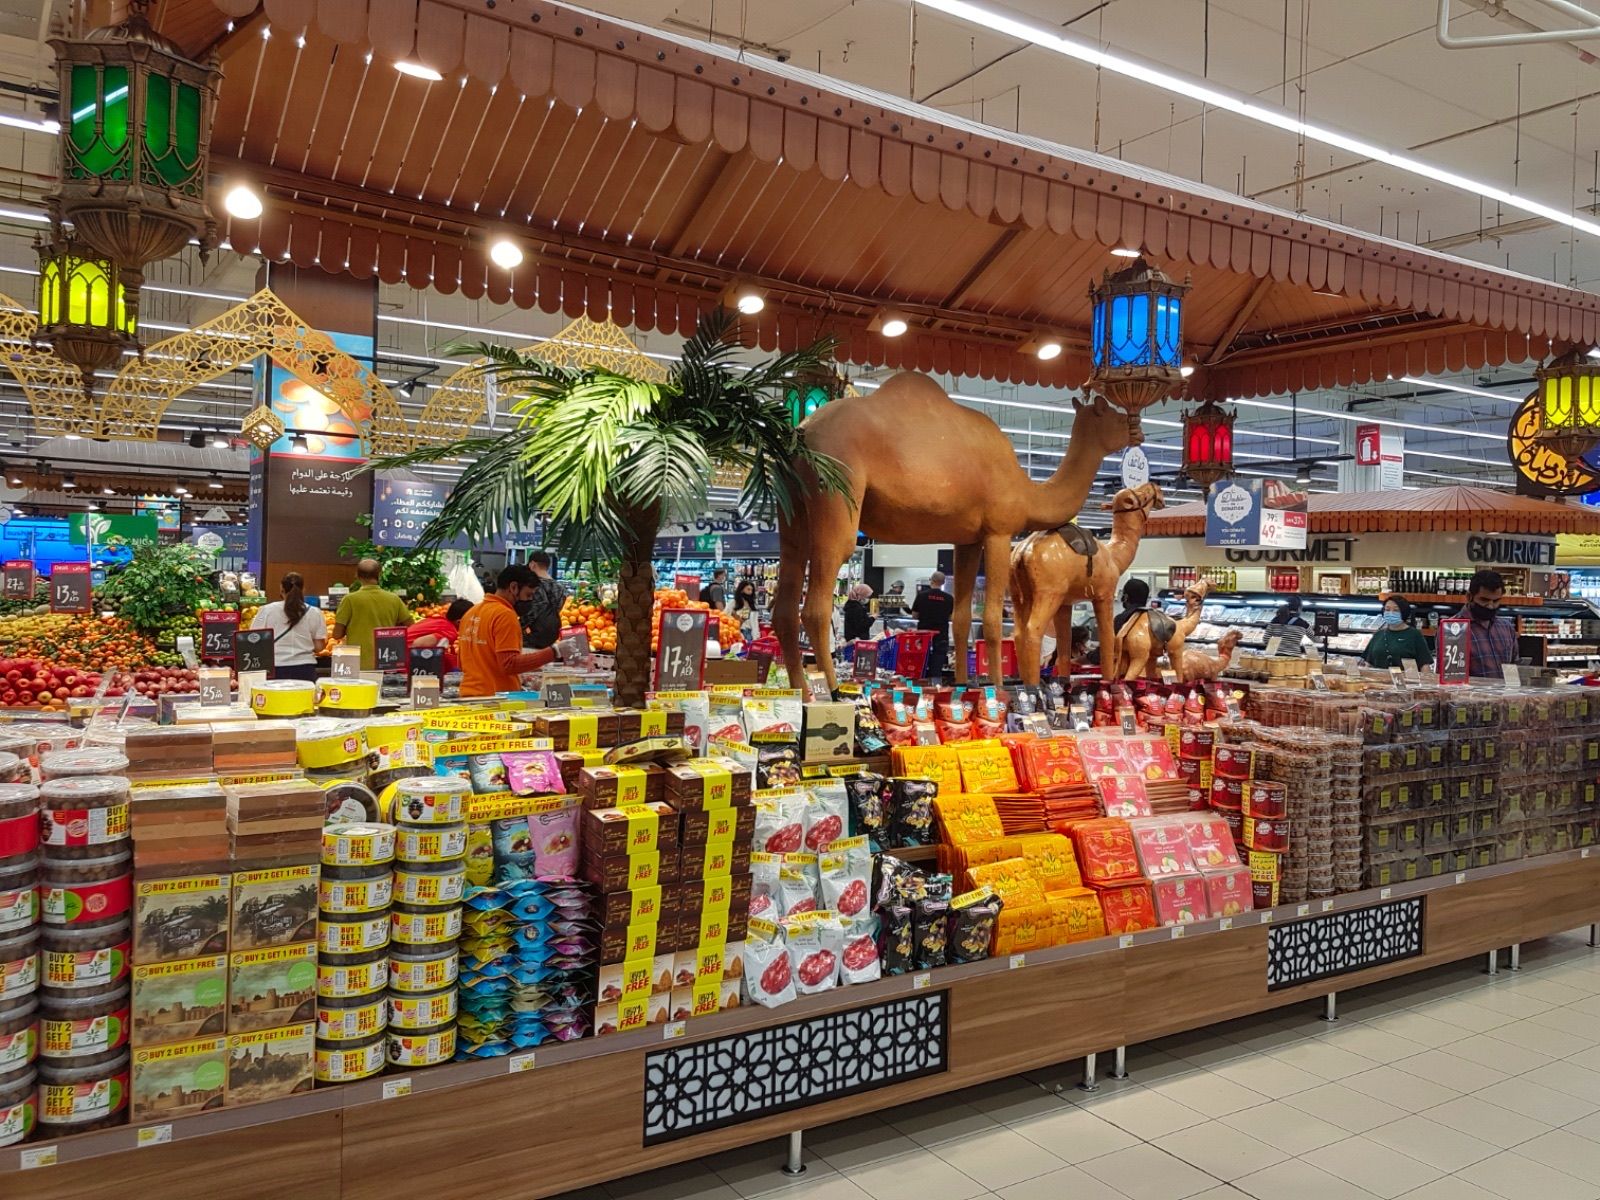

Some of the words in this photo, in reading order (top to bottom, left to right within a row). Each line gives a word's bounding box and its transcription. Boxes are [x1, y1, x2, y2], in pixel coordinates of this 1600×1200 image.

[292, 469, 313, 478] الدوام
[316, 470, 328, 480] على
[289, 484, 308, 495] عليها
[309, 486, 331, 494] تعتمد
[332, 488, 353, 498] وقيمة
[1226, 538, 1354, 562] GOURMET
[1467, 536, 1557, 565] GOURMET
[680, 666, 692, 675] AED
[490, 723, 512, 731] FREE
[450, 745, 469, 753] BUY
[480, 743, 496, 751] GET
[509, 740, 533, 748] FREE
[107, 806, 121, 817] BUY
[470, 811, 491, 820] BUY
[494, 810, 501, 818] 2
[504, 807, 523, 816] GET
[536, 802, 562, 811] FREE
[107, 816, 122, 826] GET
[634, 834, 651, 846] FREE
[709, 861, 725, 871] FREE
[248, 873, 262, 881] BUY
[271, 870, 284, 879] GET
[292, 868, 310, 876] FREE
[635, 870, 652, 881] FREE
[153, 883, 168, 892] BUY
[177, 881, 191, 889] GET
[201, 879, 220, 887] FREE
[637, 905, 654, 916] FREE
[49, 953, 62, 963] BUY
[69, 954, 75, 962] 2
[245, 954, 258, 962] BUY
[267, 951, 281, 960] GET
[289, 948, 306, 956] FREE
[49, 964, 66, 973] GET
[149, 967, 163, 975] BUY
[173, 964, 188, 972] GET
[197, 960, 216, 969] FREE
[49, 973, 74, 982] FREE
[625, 978, 650, 994] FREE
[619, 1014, 644, 1029] FREE
[46, 1022, 62, 1032] BUY
[65, 1022, 71, 1030] 2
[46, 1032, 63, 1041] GET
[68, 1033, 72, 1041] 1
[241, 1034, 255, 1043] BUY
[264, 1032, 278, 1040] GET
[286, 1028, 303, 1037] FREE
[46, 1041, 71, 1050] FREE
[149, 1050, 164, 1059] BUY
[174, 1047, 188, 1056] GET
[197, 1043, 216, 1052] FREE
[47, 1087, 64, 1096] BUY
[67, 1087, 73, 1095] 2
[46, 1097, 63, 1106] GET
[70, 1097, 73, 1105] 1
[46, 1107, 73, 1115] FREE
